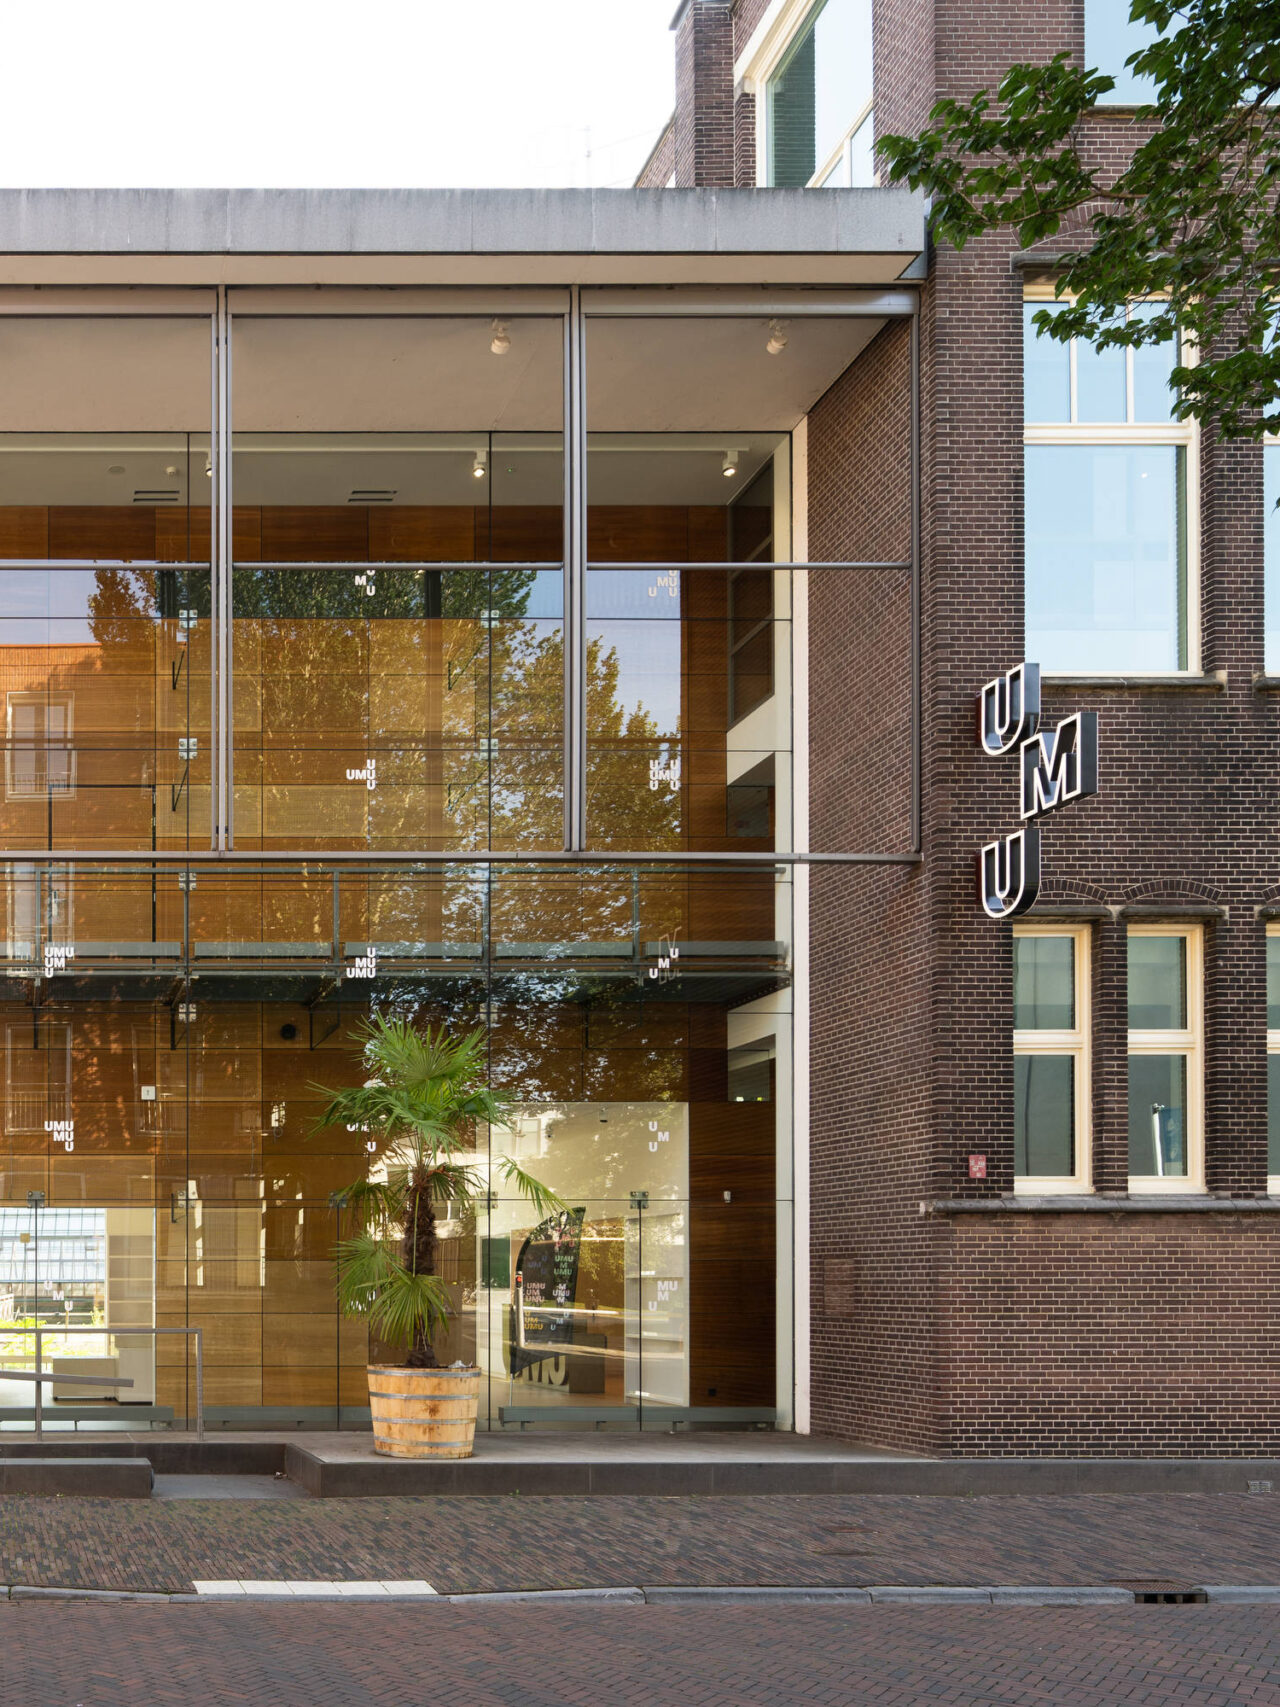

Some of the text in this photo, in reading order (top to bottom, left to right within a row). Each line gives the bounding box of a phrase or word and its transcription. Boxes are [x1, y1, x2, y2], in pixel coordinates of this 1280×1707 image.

[346, 769, 375, 780] UMU
[44, 947, 74, 957] UMU
[44, 957, 65, 968] UM
[355, 957, 376, 968] MU
[346, 967, 376, 978] UMU
[44, 1120, 74, 1131] UMU
[53, 1131, 74, 1142] MU
